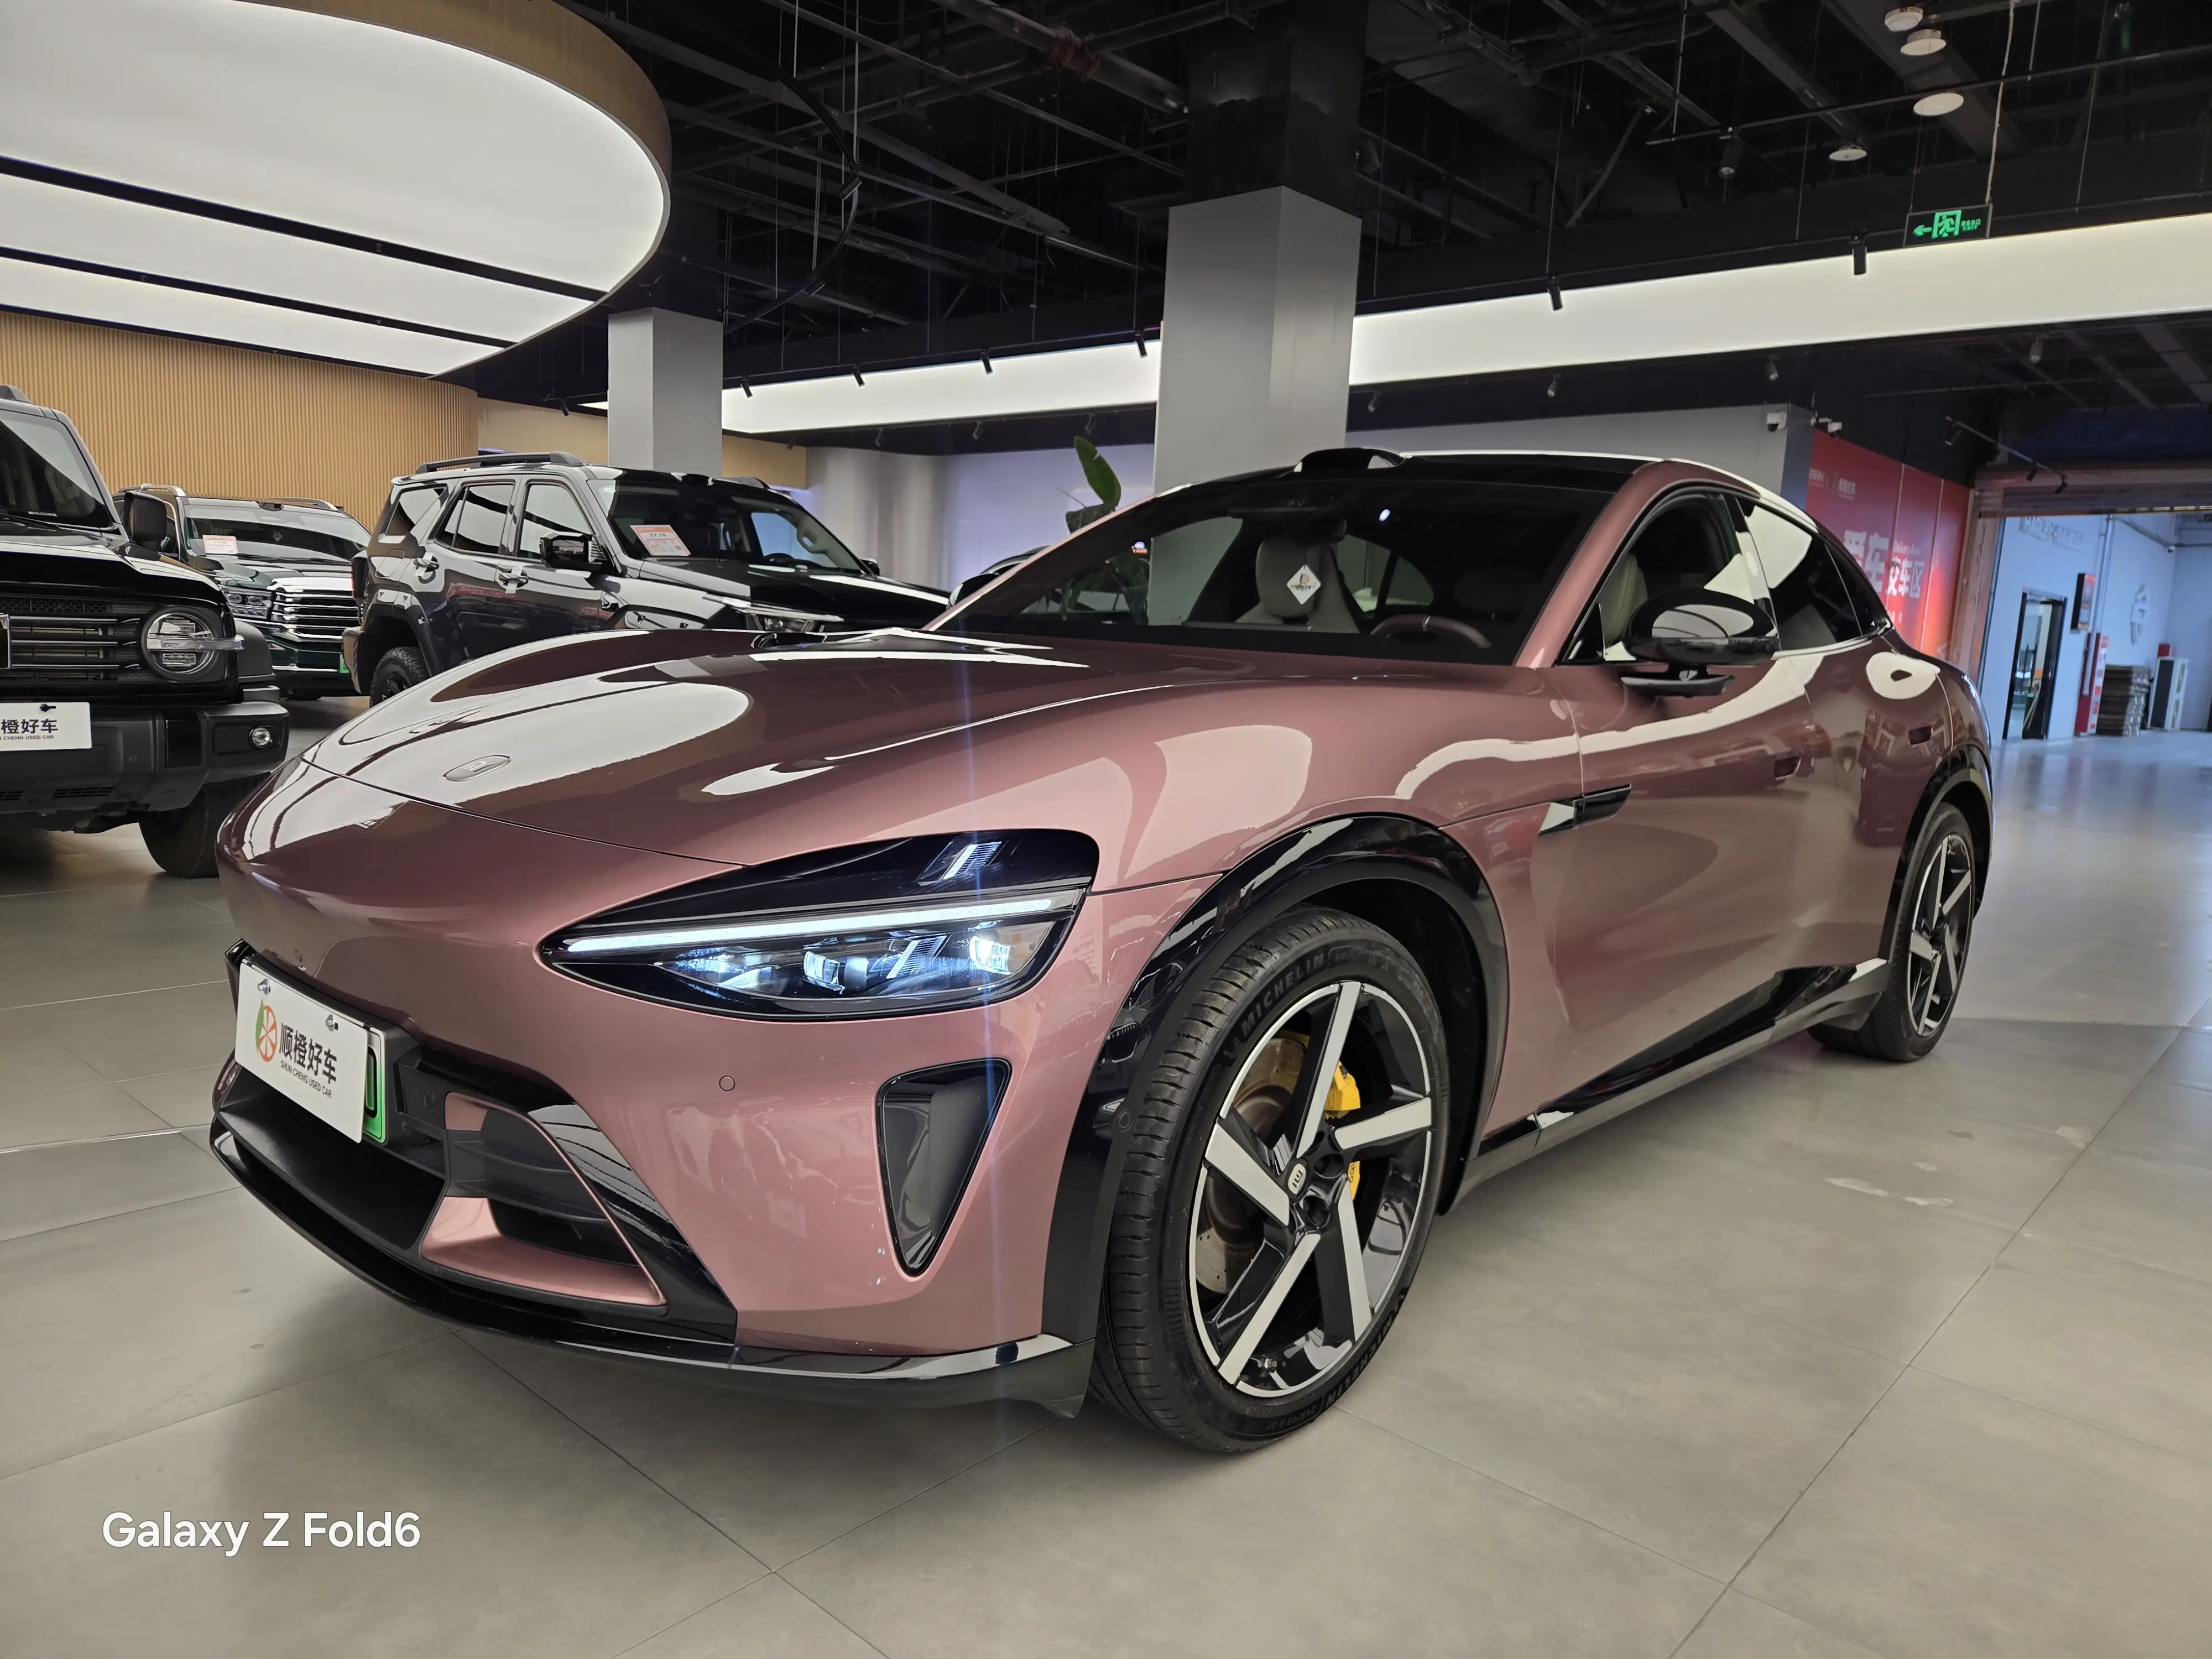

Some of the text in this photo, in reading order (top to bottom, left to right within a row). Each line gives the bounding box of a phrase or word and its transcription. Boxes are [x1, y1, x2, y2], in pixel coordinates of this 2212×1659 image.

[1, 718, 58, 734] 橙好车
[1241, 952, 1324, 1037] MICHELIN
[279, 1022, 337, 1084] 顺橙好车
[280, 1060, 332, 1099] SHUN CHENG USED CAR
